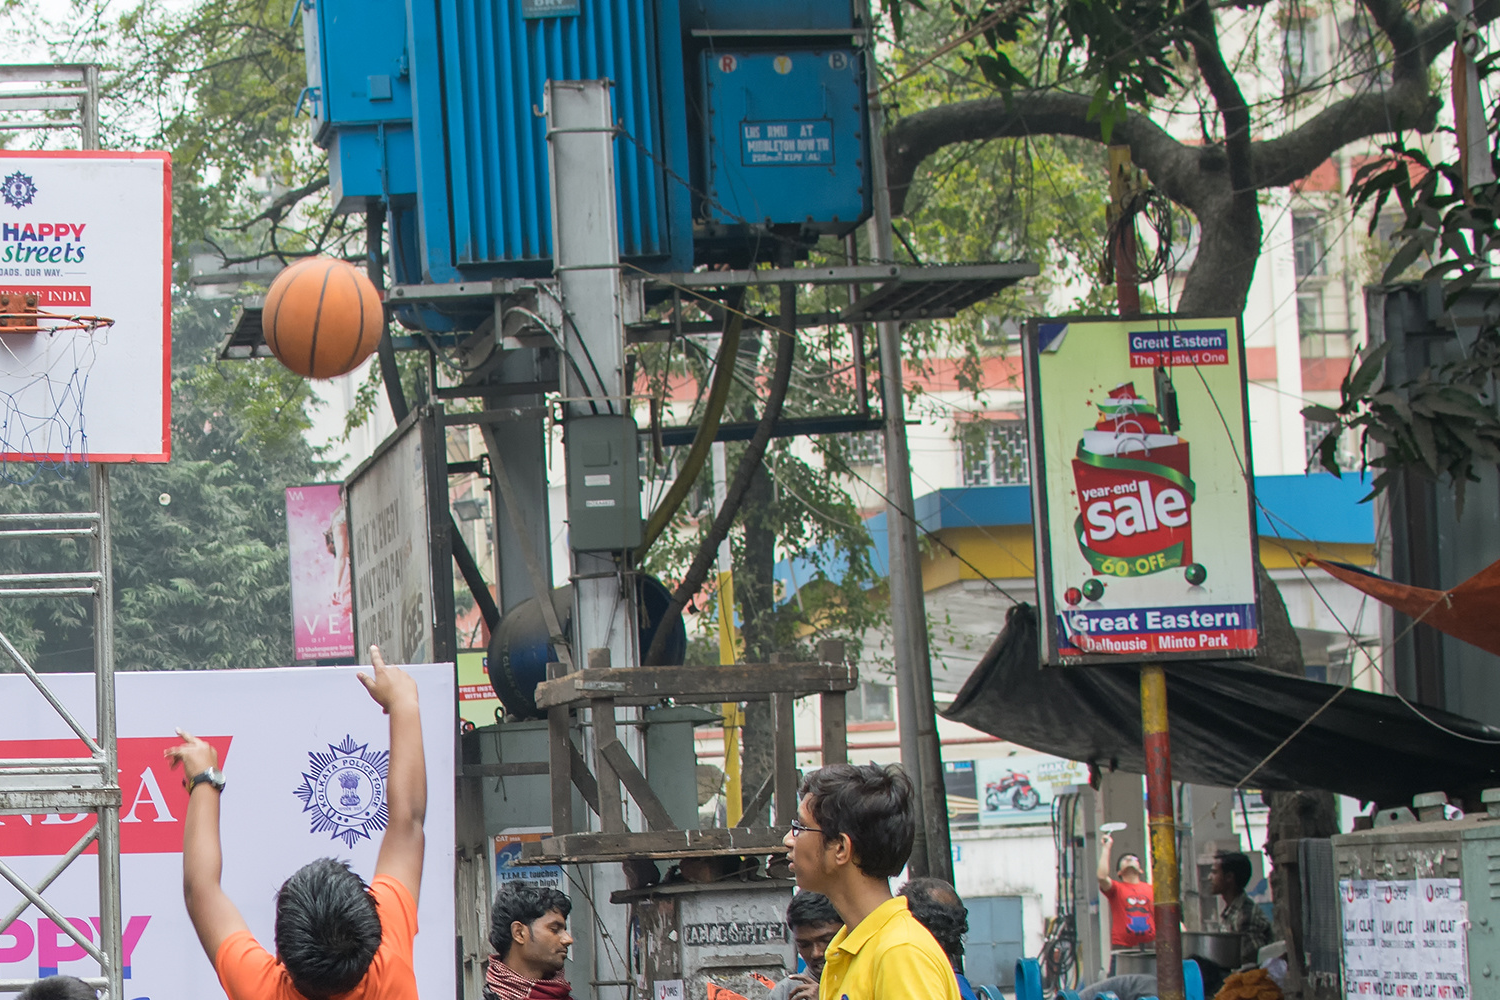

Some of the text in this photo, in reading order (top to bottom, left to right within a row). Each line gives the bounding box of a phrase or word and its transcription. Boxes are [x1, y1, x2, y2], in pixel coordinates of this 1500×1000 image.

[722, 53, 844, 74] R Y B
[800, 124, 814, 137] AT
[2, 222, 87, 242] HAPPY
[1, 242, 86, 263] streets
[25, 268, 41, 277] OUR
[43, 269, 63, 277] WAY.
[48, 290, 86, 302] INDIA
[1132, 334, 1222, 350] Great Eastern
[1133, 355, 1154, 365] The
[1202, 352, 1225, 363] One
[1082, 480, 1138, 501] year-end
[1086, 480, 1189, 541] sale
[1135, 553, 1166, 574] OFF
[303, 613, 354, 636] VE
[1072, 610, 1240, 632] Great Eastern
[1087, 634, 1229, 652] Dalhousie Minto Park
[317, 759, 382, 808] KOLKATA POLICE FORCE
[529, 869, 559, 879] touches
[1359, 919, 1374, 932] CLAT
[1397, 920, 1412, 934] CLAT
[1440, 920, 1456, 933] CLAT
